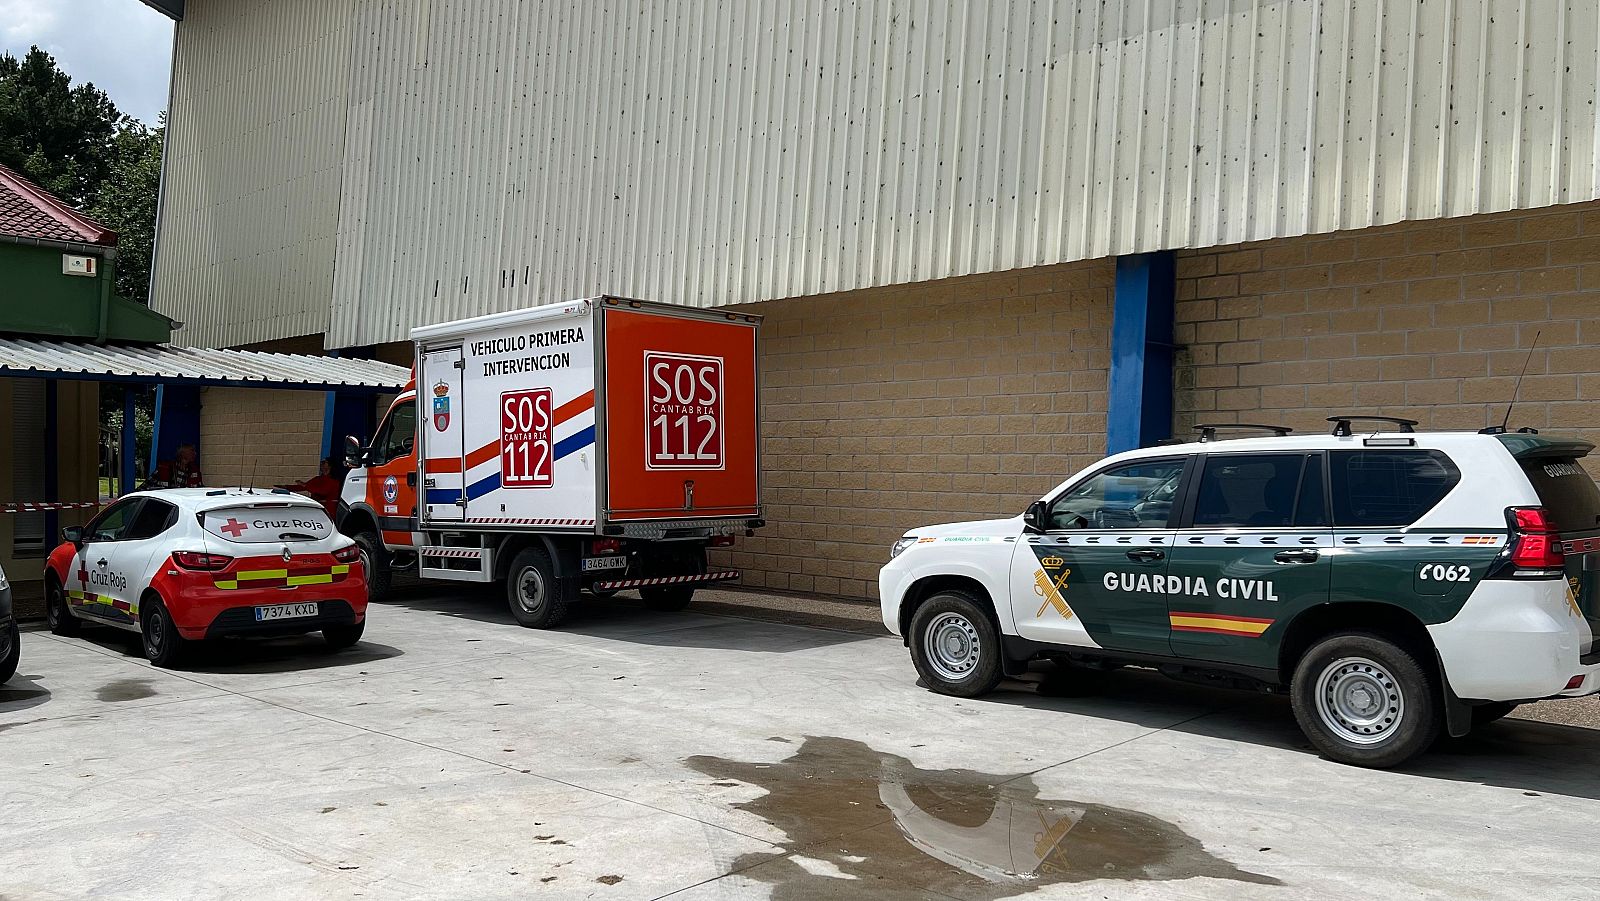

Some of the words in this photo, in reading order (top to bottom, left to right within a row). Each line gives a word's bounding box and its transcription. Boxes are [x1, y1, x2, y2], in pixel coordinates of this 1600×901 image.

[470, 335, 526, 357] VEHICULO
[528, 327, 585, 349] PRIMERA
[483, 352, 570, 377] INTERVENCION
[652, 362, 717, 406] SOS
[504, 395, 549, 433] SOS
[652, 403, 715, 415] CANTABRIA
[504, 431, 548, 442] CANTABRIA
[653, 414, 717, 460] 112
[504, 439, 549, 481] 112
[253, 519, 290, 530] Cruz
[292, 519, 325, 530] Roja
[587, 558, 608, 569] 3464
[610, 557, 625, 568] GWK
[1432, 564, 1471, 582] 062
[91, 569, 109, 586] Cruz
[109, 571, 127, 592] Roja
[1103, 571, 1210, 597] GUARDIA
[1216, 578, 1280, 602] CIVIL
[263, 606, 292, 619] 7374
[294, 604, 315, 616] KXD
